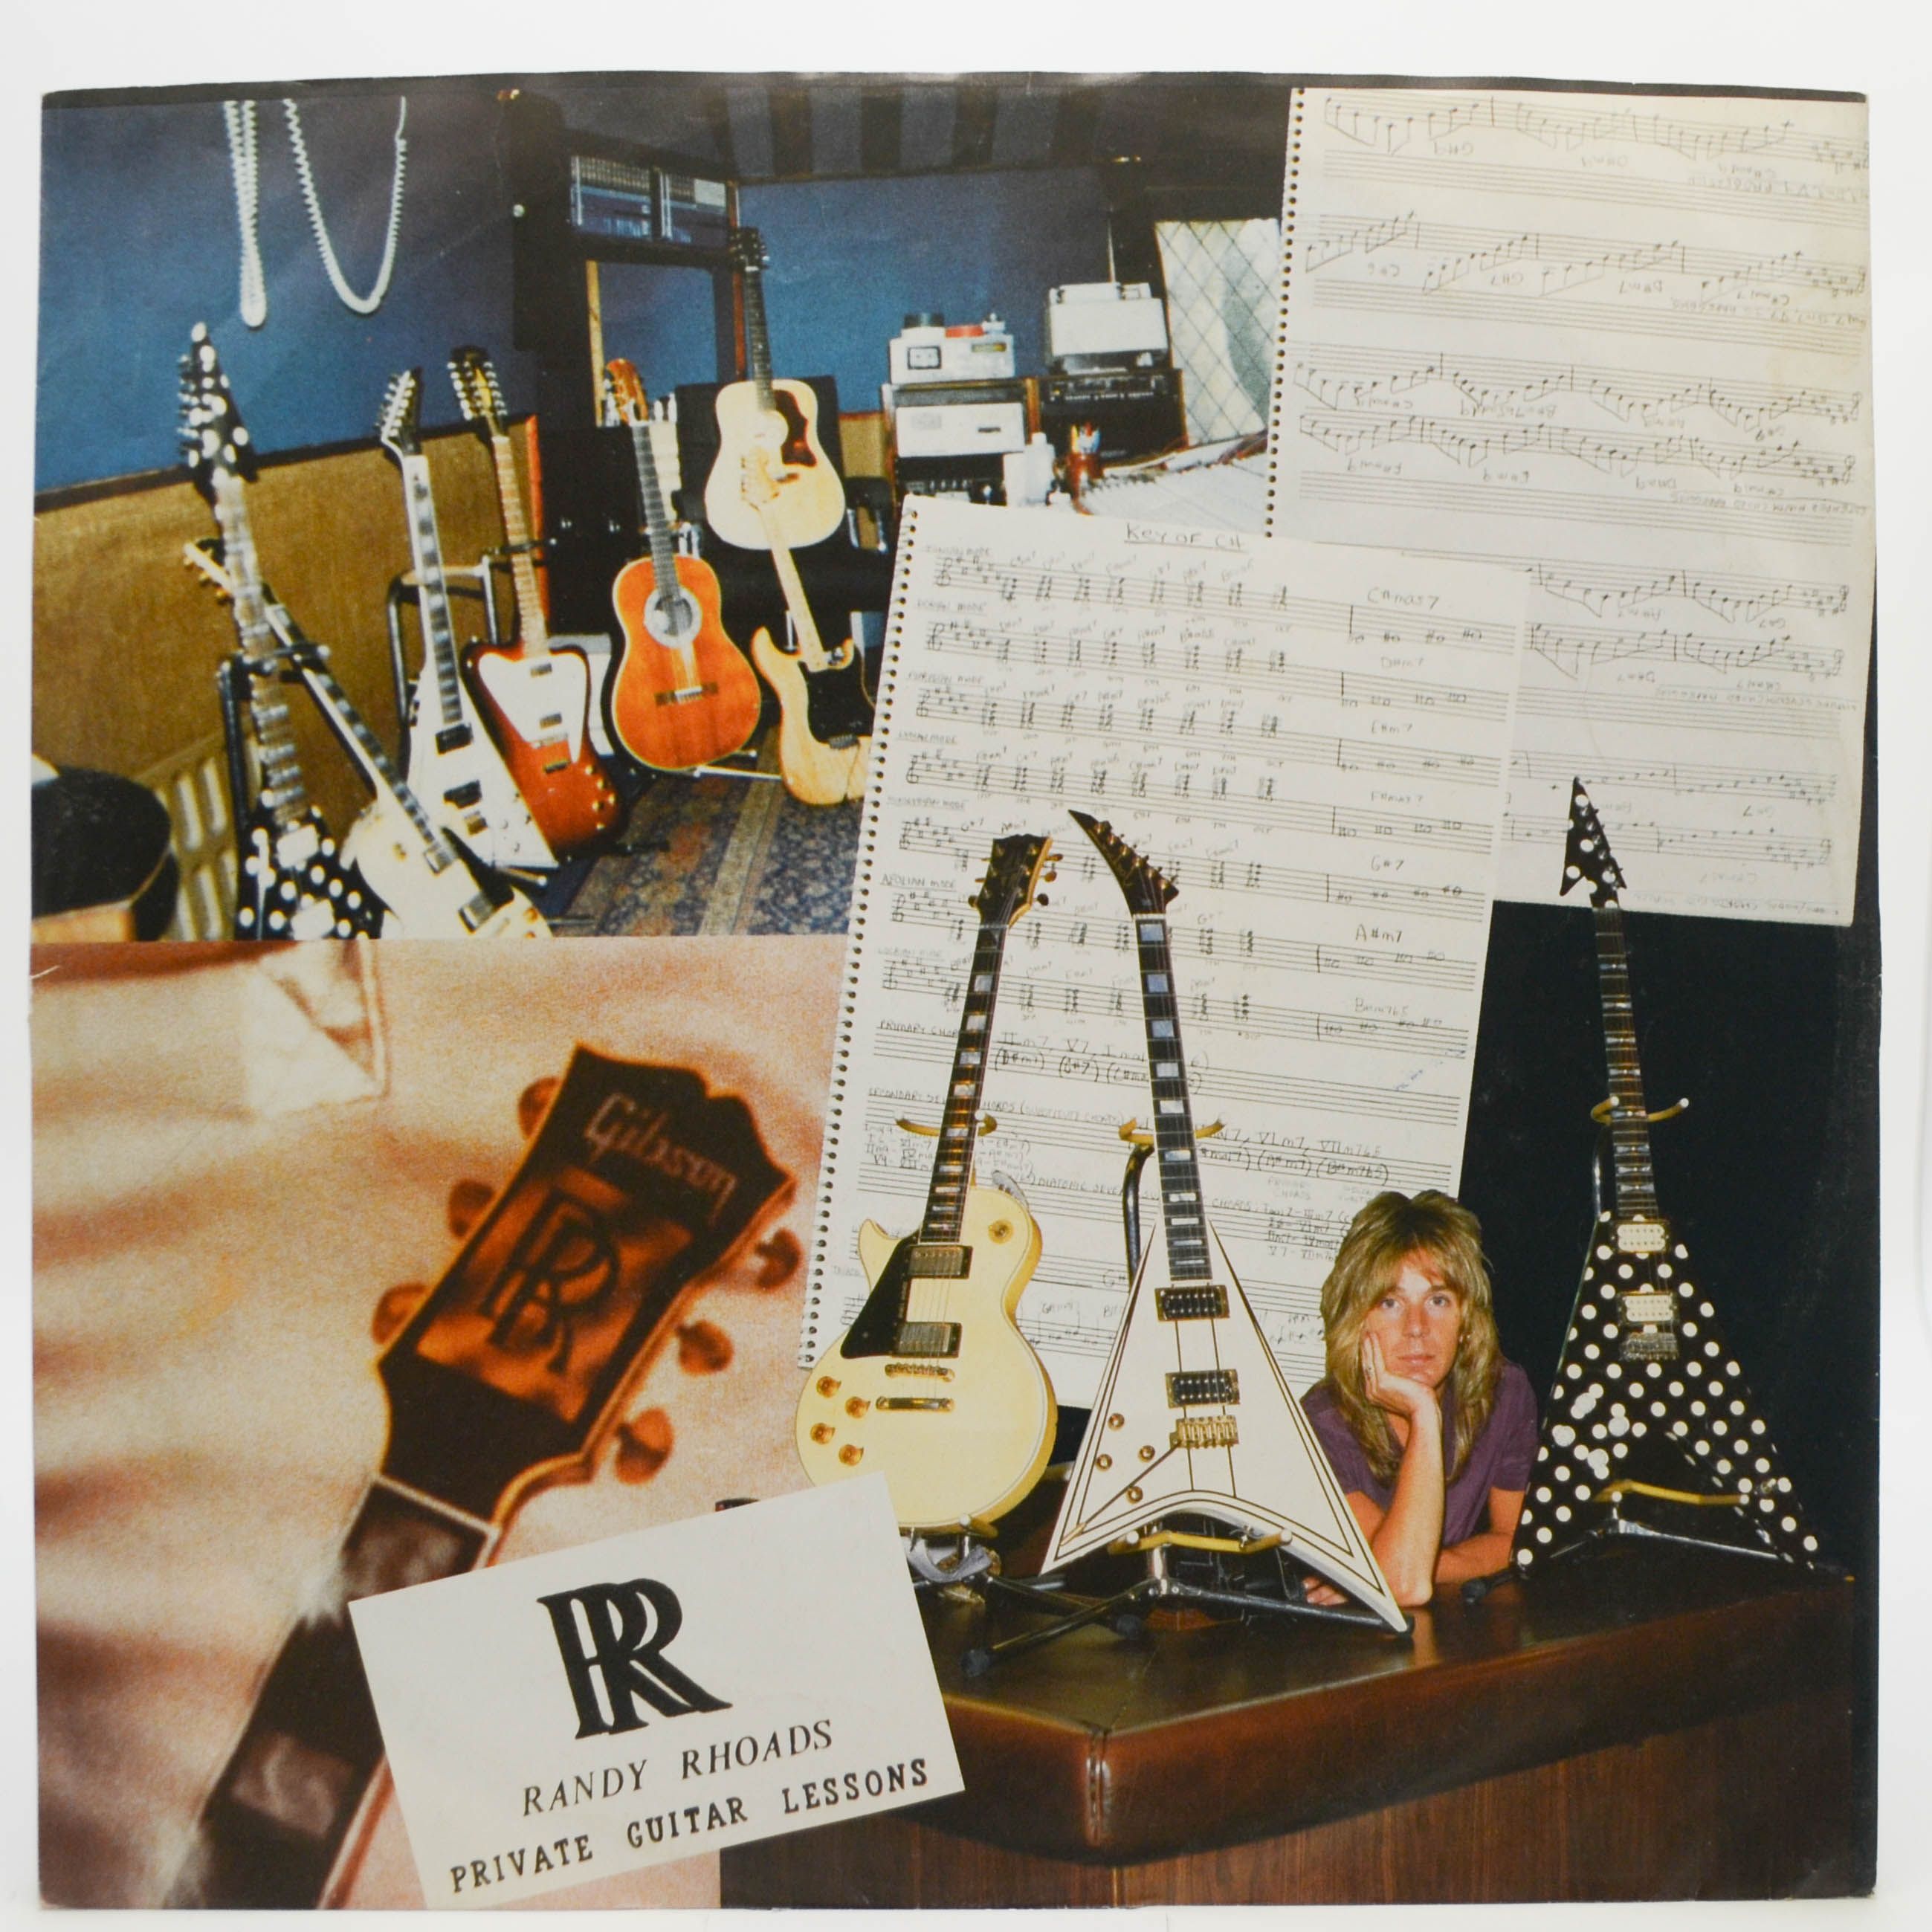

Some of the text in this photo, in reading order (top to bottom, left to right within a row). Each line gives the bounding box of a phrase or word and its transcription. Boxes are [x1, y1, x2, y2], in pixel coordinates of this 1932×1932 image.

[584, 1091, 738, 1226] Gibson
[450, 1758, 928, 1893] PRIVATE GUITAR LESSONS
[523, 1719, 833, 1817] RANDY RHOADS
